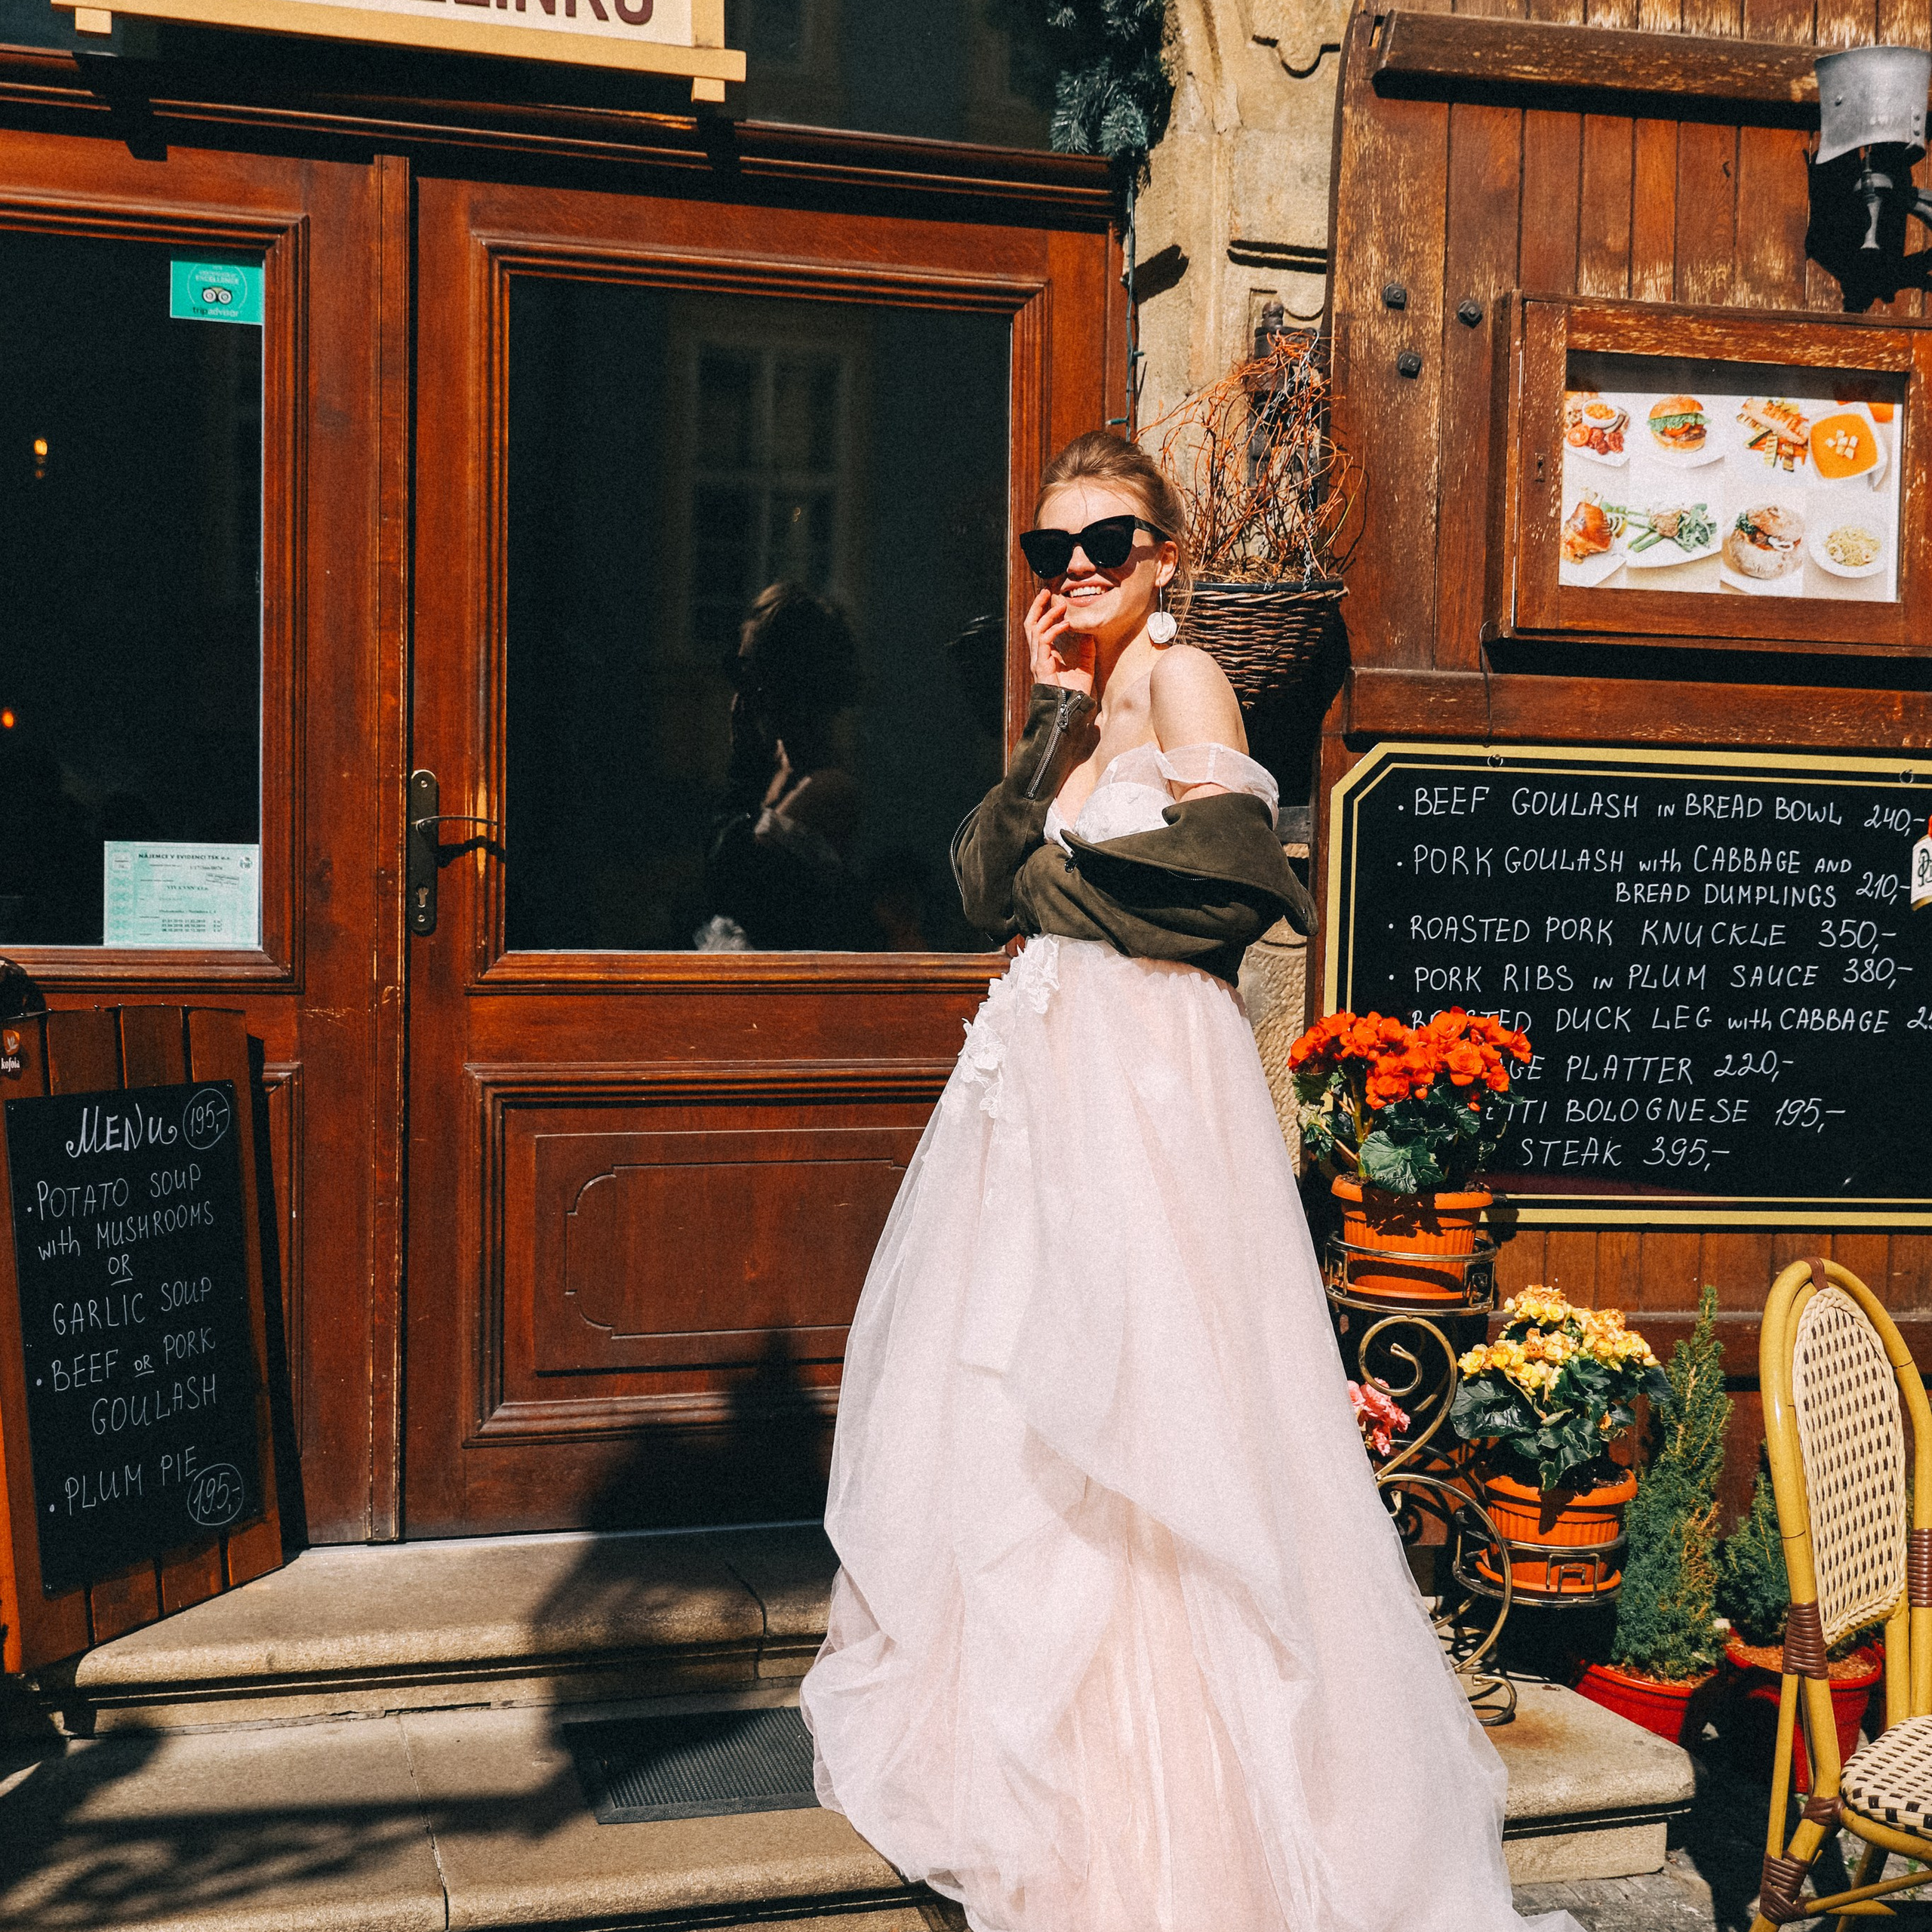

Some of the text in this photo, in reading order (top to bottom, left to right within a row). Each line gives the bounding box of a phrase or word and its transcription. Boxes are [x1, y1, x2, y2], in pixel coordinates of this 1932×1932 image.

[1414, 786, 1491, 816] BEEF
[1512, 786, 1638, 819] GOULASH
[1684, 792, 1763, 820] BREAD
[1775, 796, 1842, 826] BOWL
[1414, 844, 1852, 878] PORK GOULASH with CABBAGE AND
[1615, 881, 1690, 904] BREAD
[1704, 883, 1837, 909] DUMPLINGS
[1410, 914, 1531, 943] ROASTED
[1546, 915, 1614, 946] PORK
[1641, 919, 1786, 948] KNUCKLE
[1414, 965, 1482, 993] PORK
[1503, 963, 1574, 993] RIBS
[1628, 963, 1706, 990] PLUM
[1730, 964, 1819, 988] SAUCE
[1555, 1005, 1632, 1033] DUCK
[1651, 1004, 1712, 1030] LEG
[1727, 1008, 1772, 1031] with
[1780, 1007, 1890, 1034] CABBAGE
[1, 1057, 20, 1072] kofola
[1566, 1054, 1694, 1085] PLATTER
[1565, 1097, 1749, 1124] BOLOGNESE
[1521, 1137, 1622, 1167] STEAK
[37, 1164, 201, 1220] POTATO SOUP
[38, 1201, 214, 1260] with MUSHROOMS
[108, 1254, 134, 1277] OR
[53, 1277, 211, 1336] GARLIC SOUP
[51, 1327, 216, 1392] BEEF OR PORK
[91, 1374, 217, 1435] GOULASH
[65, 1446, 197, 1516] PLUM PIE
